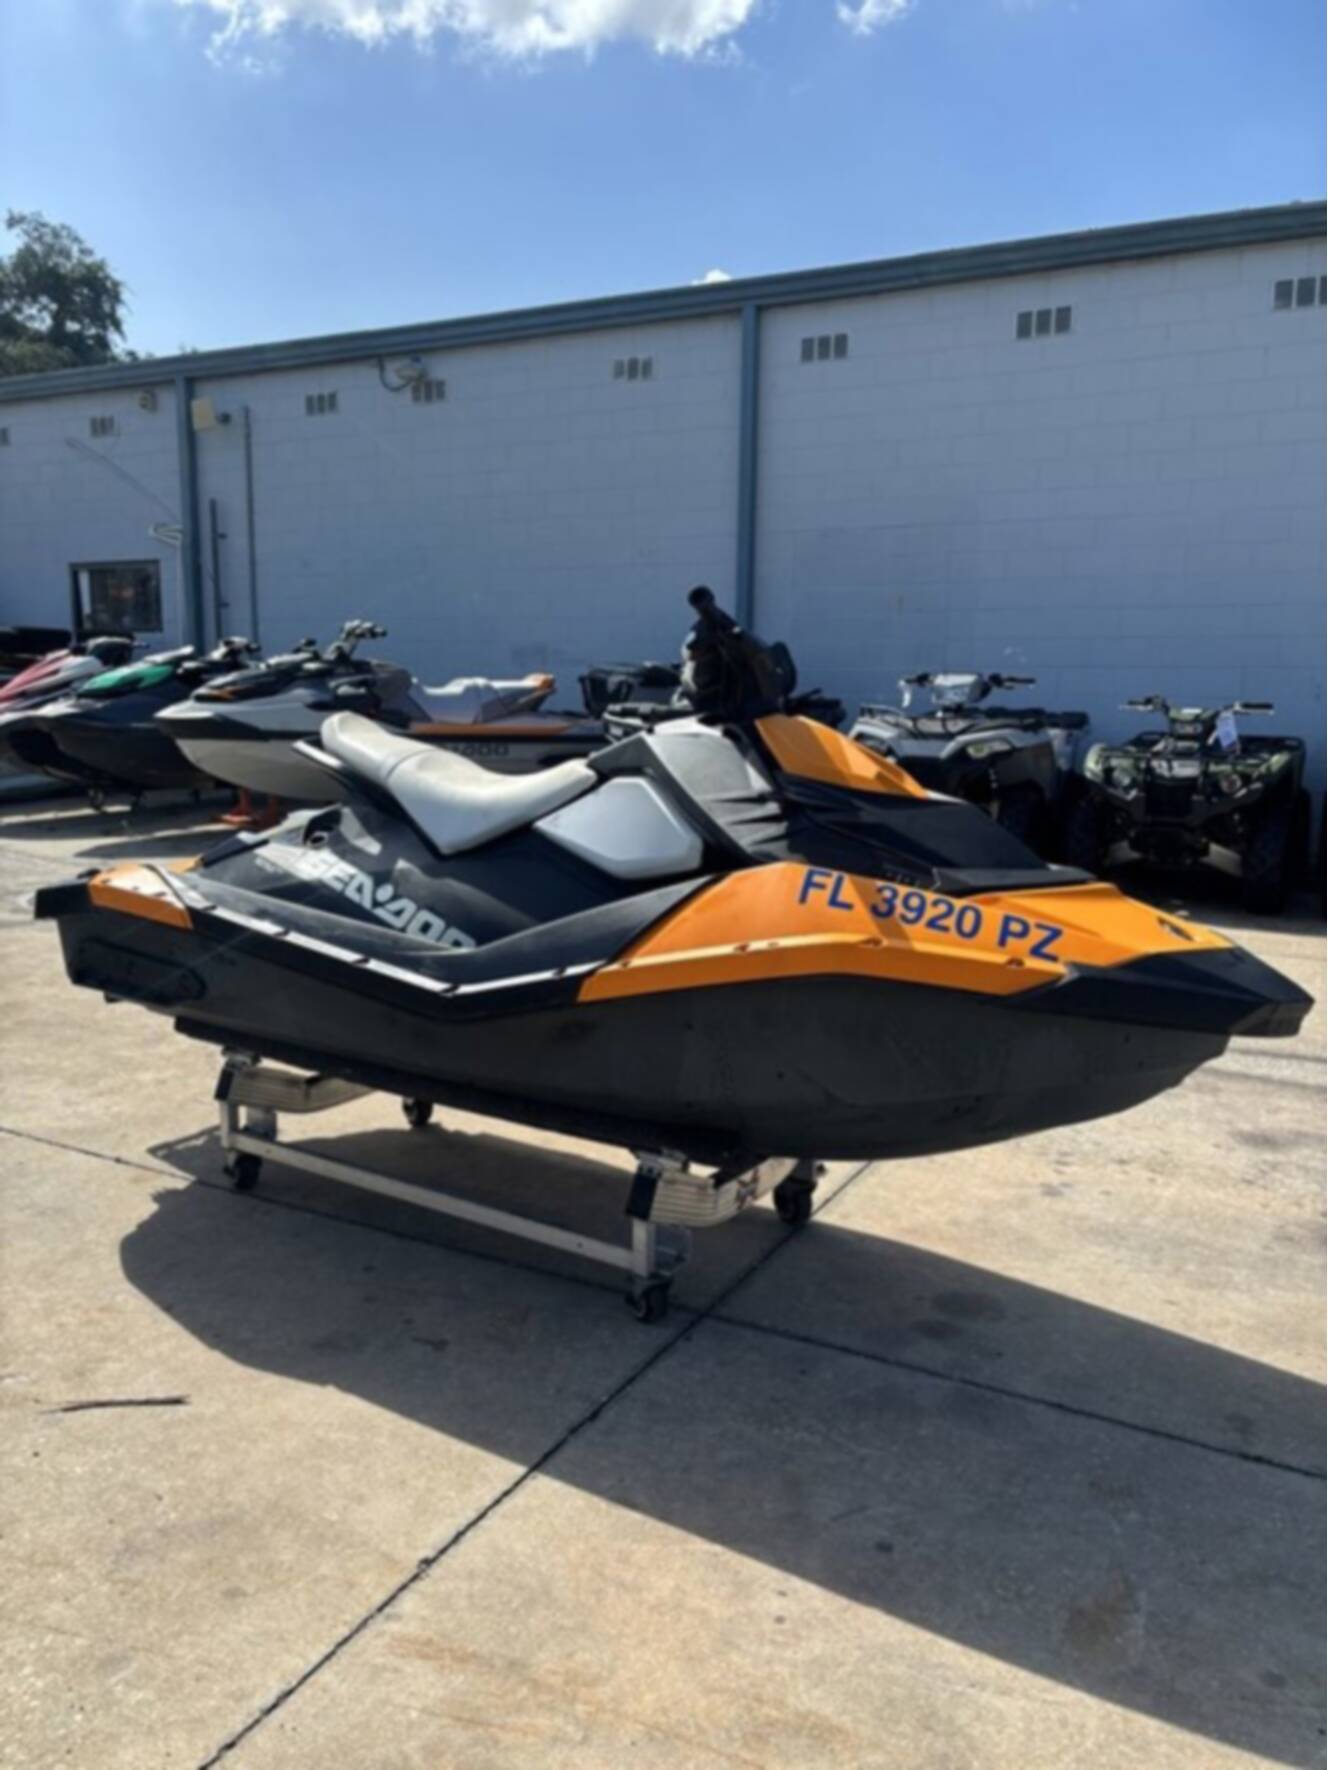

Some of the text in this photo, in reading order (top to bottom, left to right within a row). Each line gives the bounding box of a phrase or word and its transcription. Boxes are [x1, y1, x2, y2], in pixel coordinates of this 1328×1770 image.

[797, 868, 1063, 963] FL 3920 PZ
